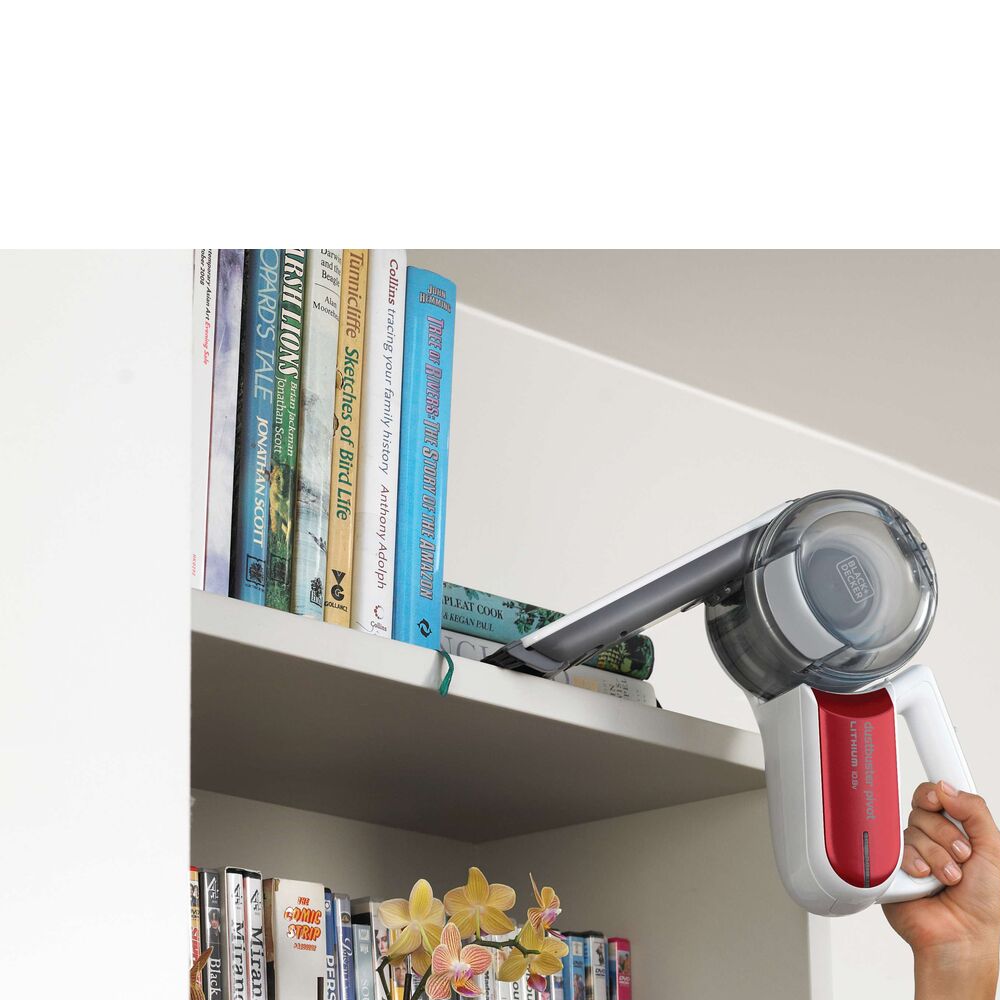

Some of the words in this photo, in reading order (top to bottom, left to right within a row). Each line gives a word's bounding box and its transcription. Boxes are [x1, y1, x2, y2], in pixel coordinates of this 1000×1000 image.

[320, 259, 333, 270] and
[387, 259, 399, 306] Collins
[324, 296, 337, 308] Alan
[345, 252, 364, 339] Tunnicliffe
[279, 308, 302, 379] LIONS
[383, 308, 396, 352] tracing
[427, 316, 445, 349] TREE
[254, 349, 274, 404] TALE
[341, 346, 360, 420] Sketches
[382, 354, 394, 379] your
[275, 376, 287, 424] Jonathan
[289, 381, 298, 410] Brian
[381, 381, 394, 425] family
[273, 427, 285, 454] Scott
[287, 409, 296, 457] Jackman
[341, 424, 356, 448] of
[379, 426, 393, 475] history
[254, 416, 269, 495] JONATHAN
[338, 452, 354, 486] Bird
[421, 446, 439, 494] STORY
[252, 497, 266, 547] SCOTT
[336, 488, 352, 522] Life
[375, 485, 390, 540] Anthony
[422, 494, 436, 512] OF
[420, 513, 435, 539] THE
[374, 542, 388, 589] Adolph
[419, 539, 436, 600] AMAZON
[840, 563, 863, 600] DECKER
[370, 620, 387, 632] Collins
[450, 614, 475, 627] KEGAN
[476, 621, 495, 633] PAUL
[476, 605, 504, 620] COOK
[849, 720, 858, 768] LITHIUM
[863, 721, 875, 786] dustbuster
[863, 789, 876, 820] pivot
[284, 906, 323, 925] COMIC
[287, 923, 321, 942] STRIP
[209, 958, 222, 996] Black
